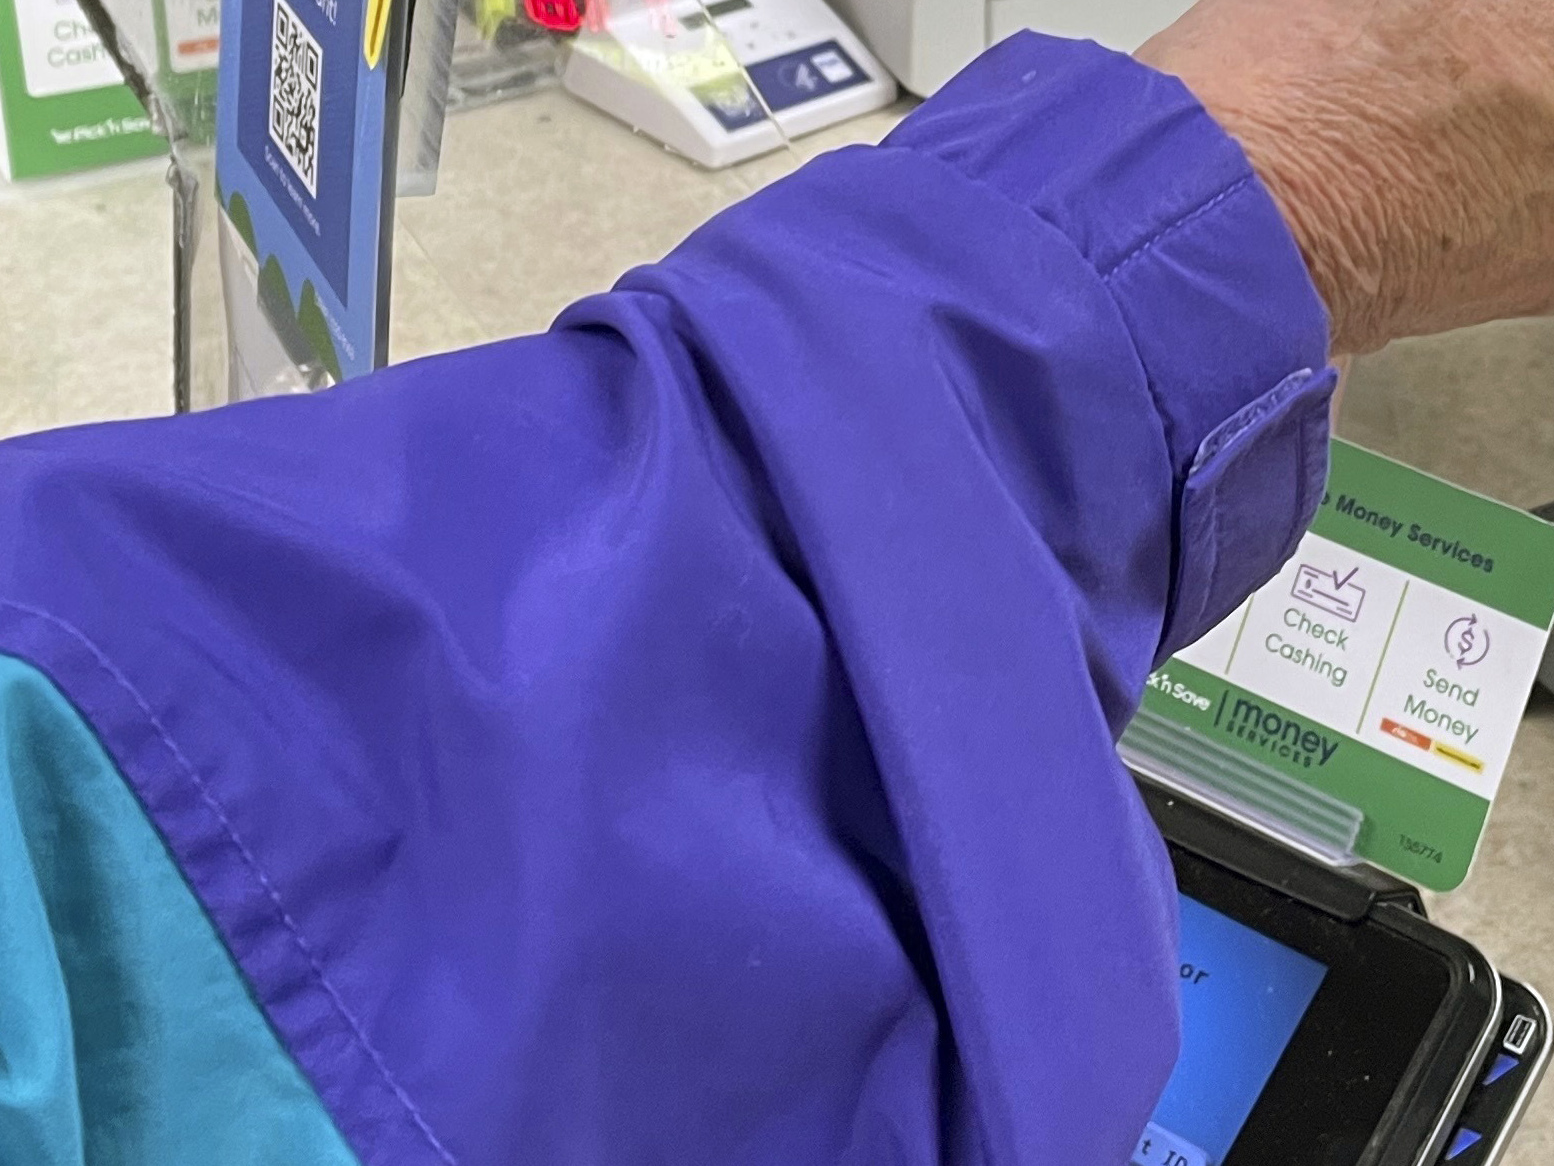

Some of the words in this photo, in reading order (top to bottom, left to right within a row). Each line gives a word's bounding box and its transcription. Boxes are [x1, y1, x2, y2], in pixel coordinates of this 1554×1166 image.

[1335, 494, 1404, 538] Money
[1407, 523, 1495, 574] Services
[1283, 606, 1350, 652] Check
[1263, 631, 1349, 688] Cashing
[1172, 682, 1213, 712] Save
[1422, 667, 1481, 708] Send
[1225, 719, 1314, 769] SERVICES
[1232, 697, 1340, 768] money
[1403, 693, 1480, 745] Money
